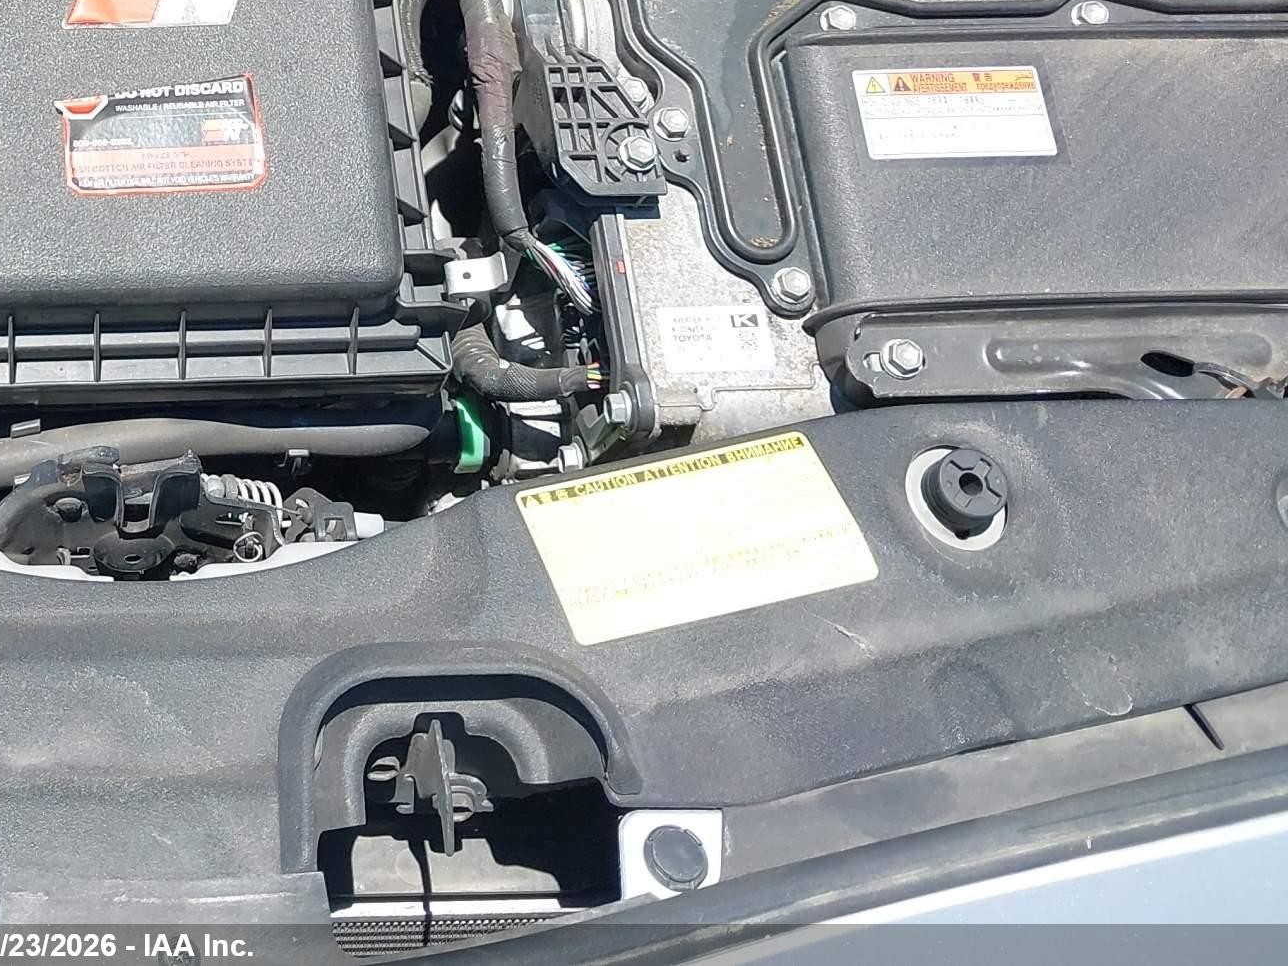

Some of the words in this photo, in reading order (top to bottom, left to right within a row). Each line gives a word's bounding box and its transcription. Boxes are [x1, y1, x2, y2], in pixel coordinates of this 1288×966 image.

[910, 73, 955, 84] WARNING
[140, 85, 173, 98] NOT
[174, 81, 245, 97] DISCARD
[911, 82, 967, 93] AVERTISSEMENT
[115, 104, 159, 113] WASHABLE
[163, 101, 204, 111] REUSABLE
[204, 100, 219, 109] AIR
[219, 99, 245, 108] FILTER
[130, 162, 145, 172] AIR
[147, 161, 177, 171] FILTER
[178, 159, 223, 170] CLEANING
[673, 334, 712, 343] TOYOTA
[575, 473, 637, 496] CAUTION
[643, 456, 722, 482] ATTENTION
